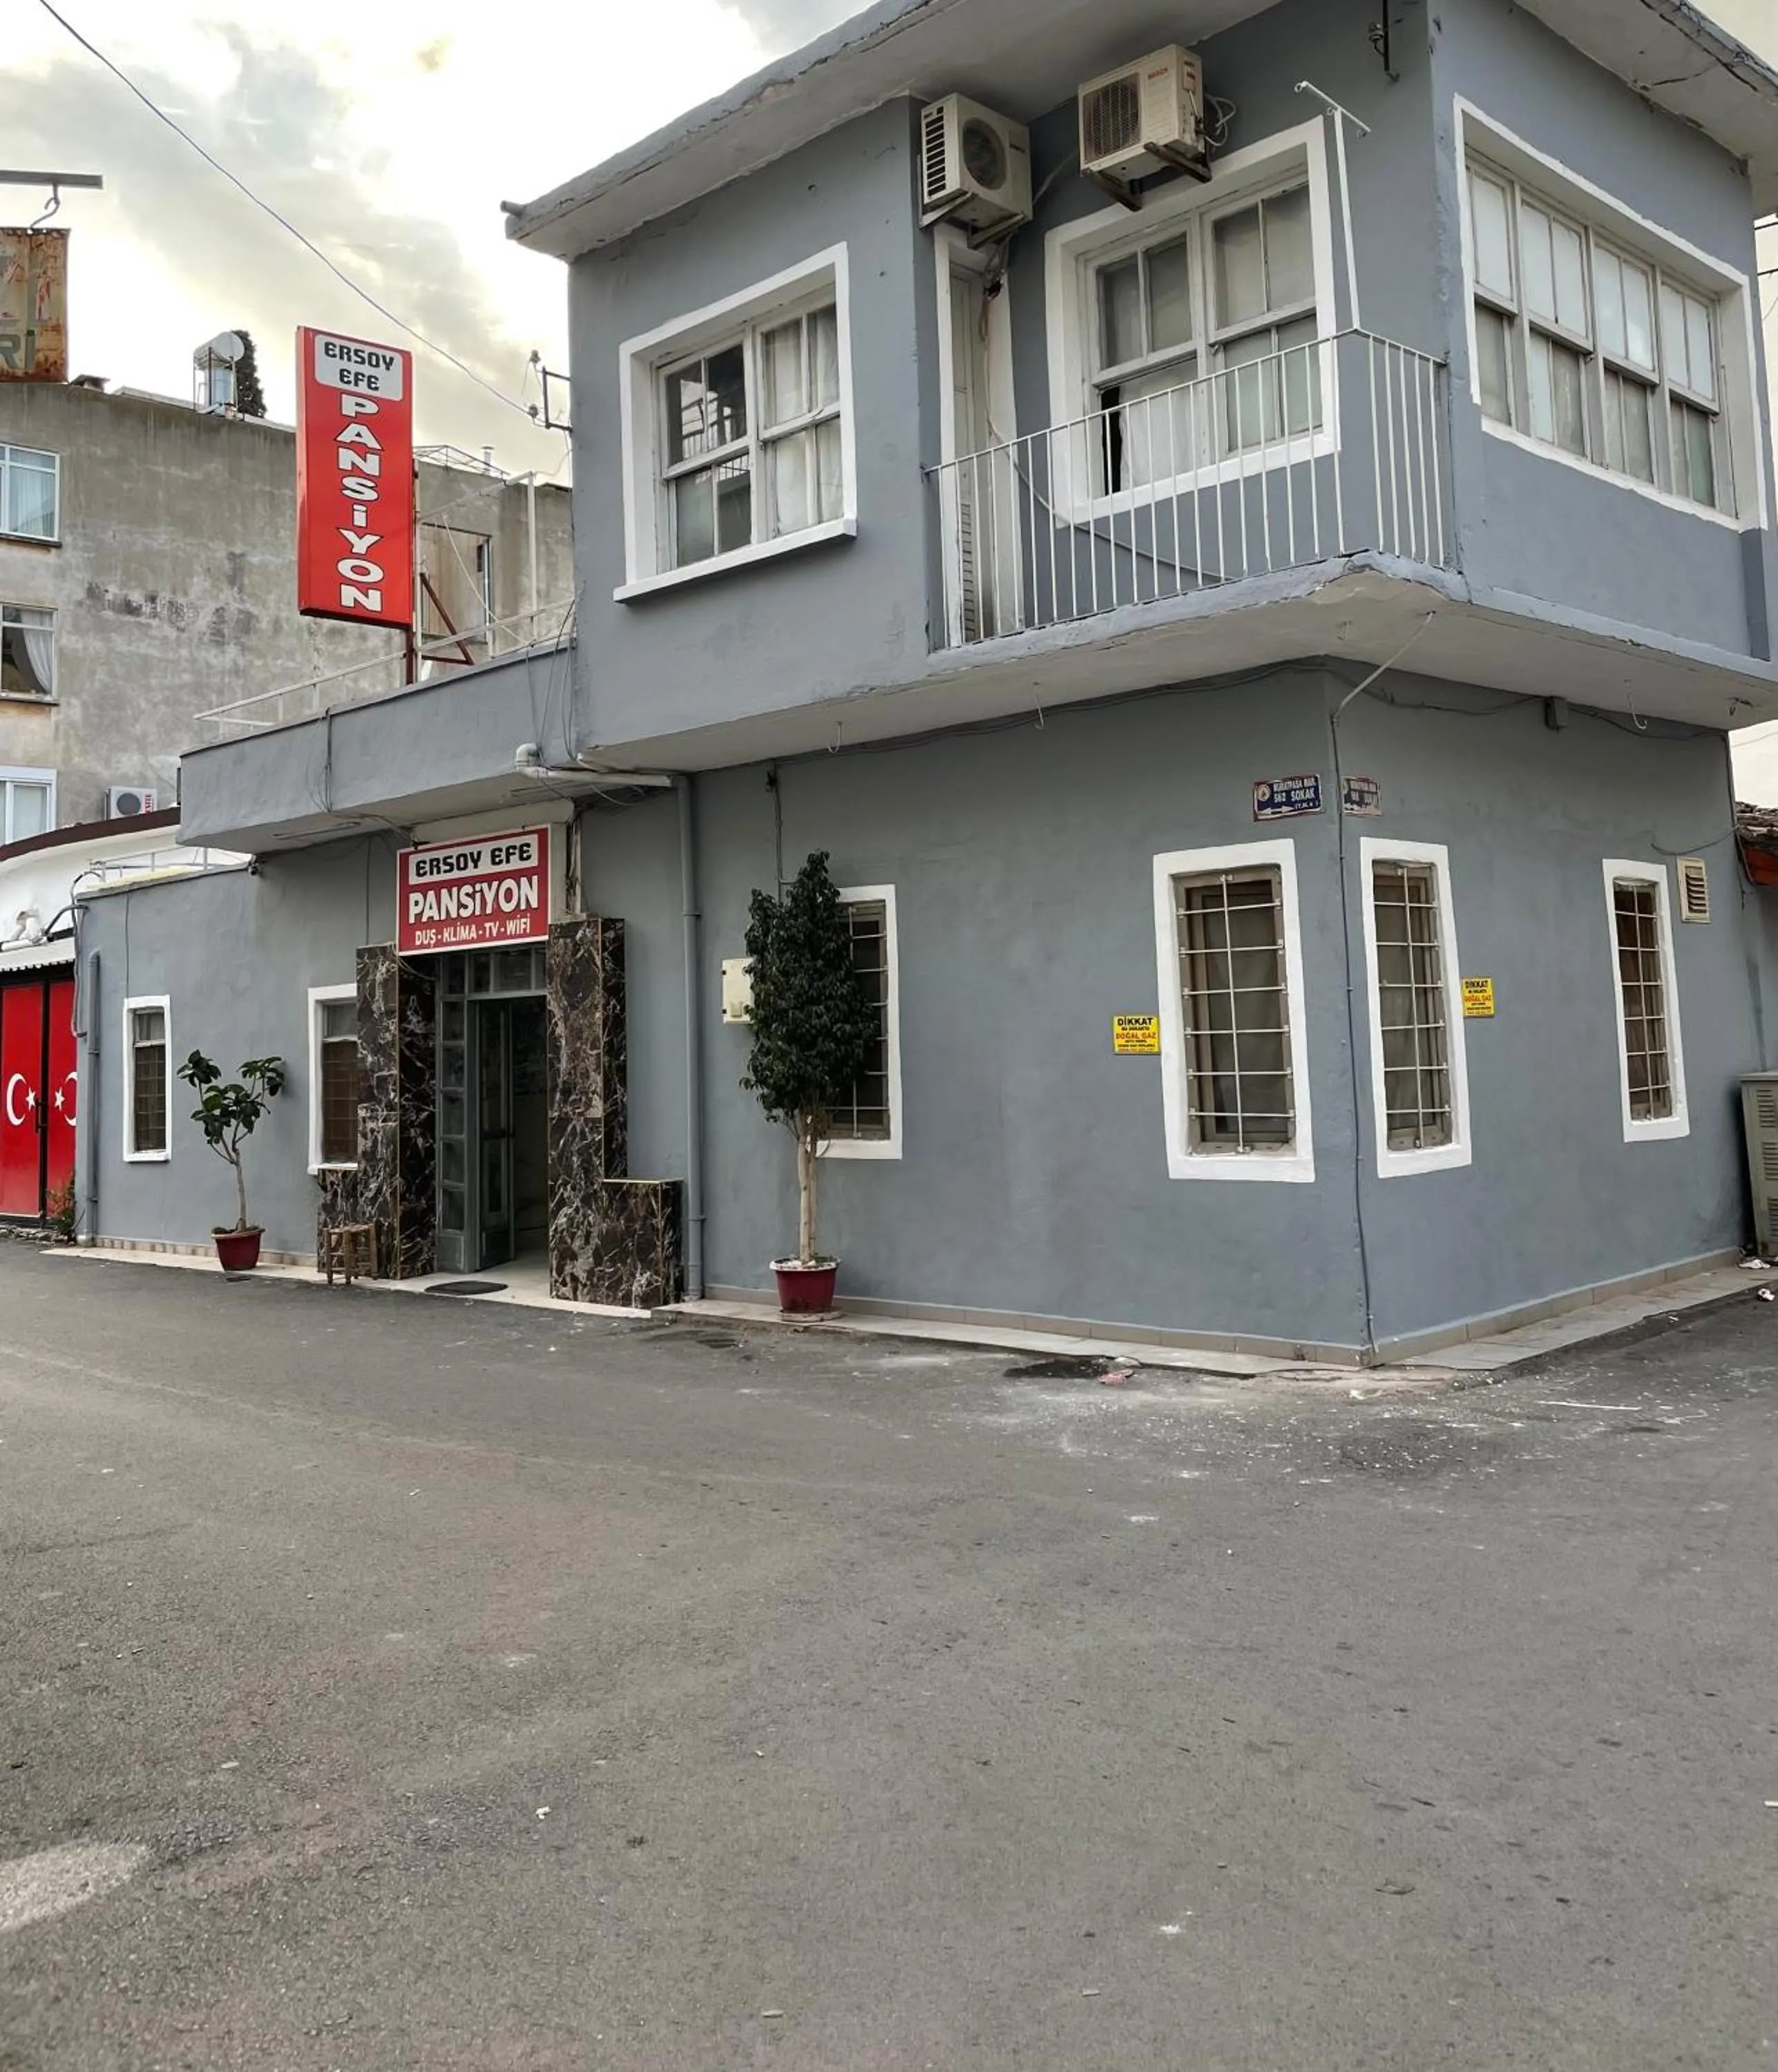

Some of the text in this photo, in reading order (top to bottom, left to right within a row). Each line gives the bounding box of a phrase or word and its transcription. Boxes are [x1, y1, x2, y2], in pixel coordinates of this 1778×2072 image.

[325, 342, 394, 371] ERSOY
[339, 369, 379, 391] EFE
[1291, 787, 1316, 801] SOKAK
[415, 843, 532, 877] ERSOY EFE
[415, 929, 436, 948] DUŞ
[443, 921, 477, 942] KLİMA
[484, 921, 499, 937] TV
